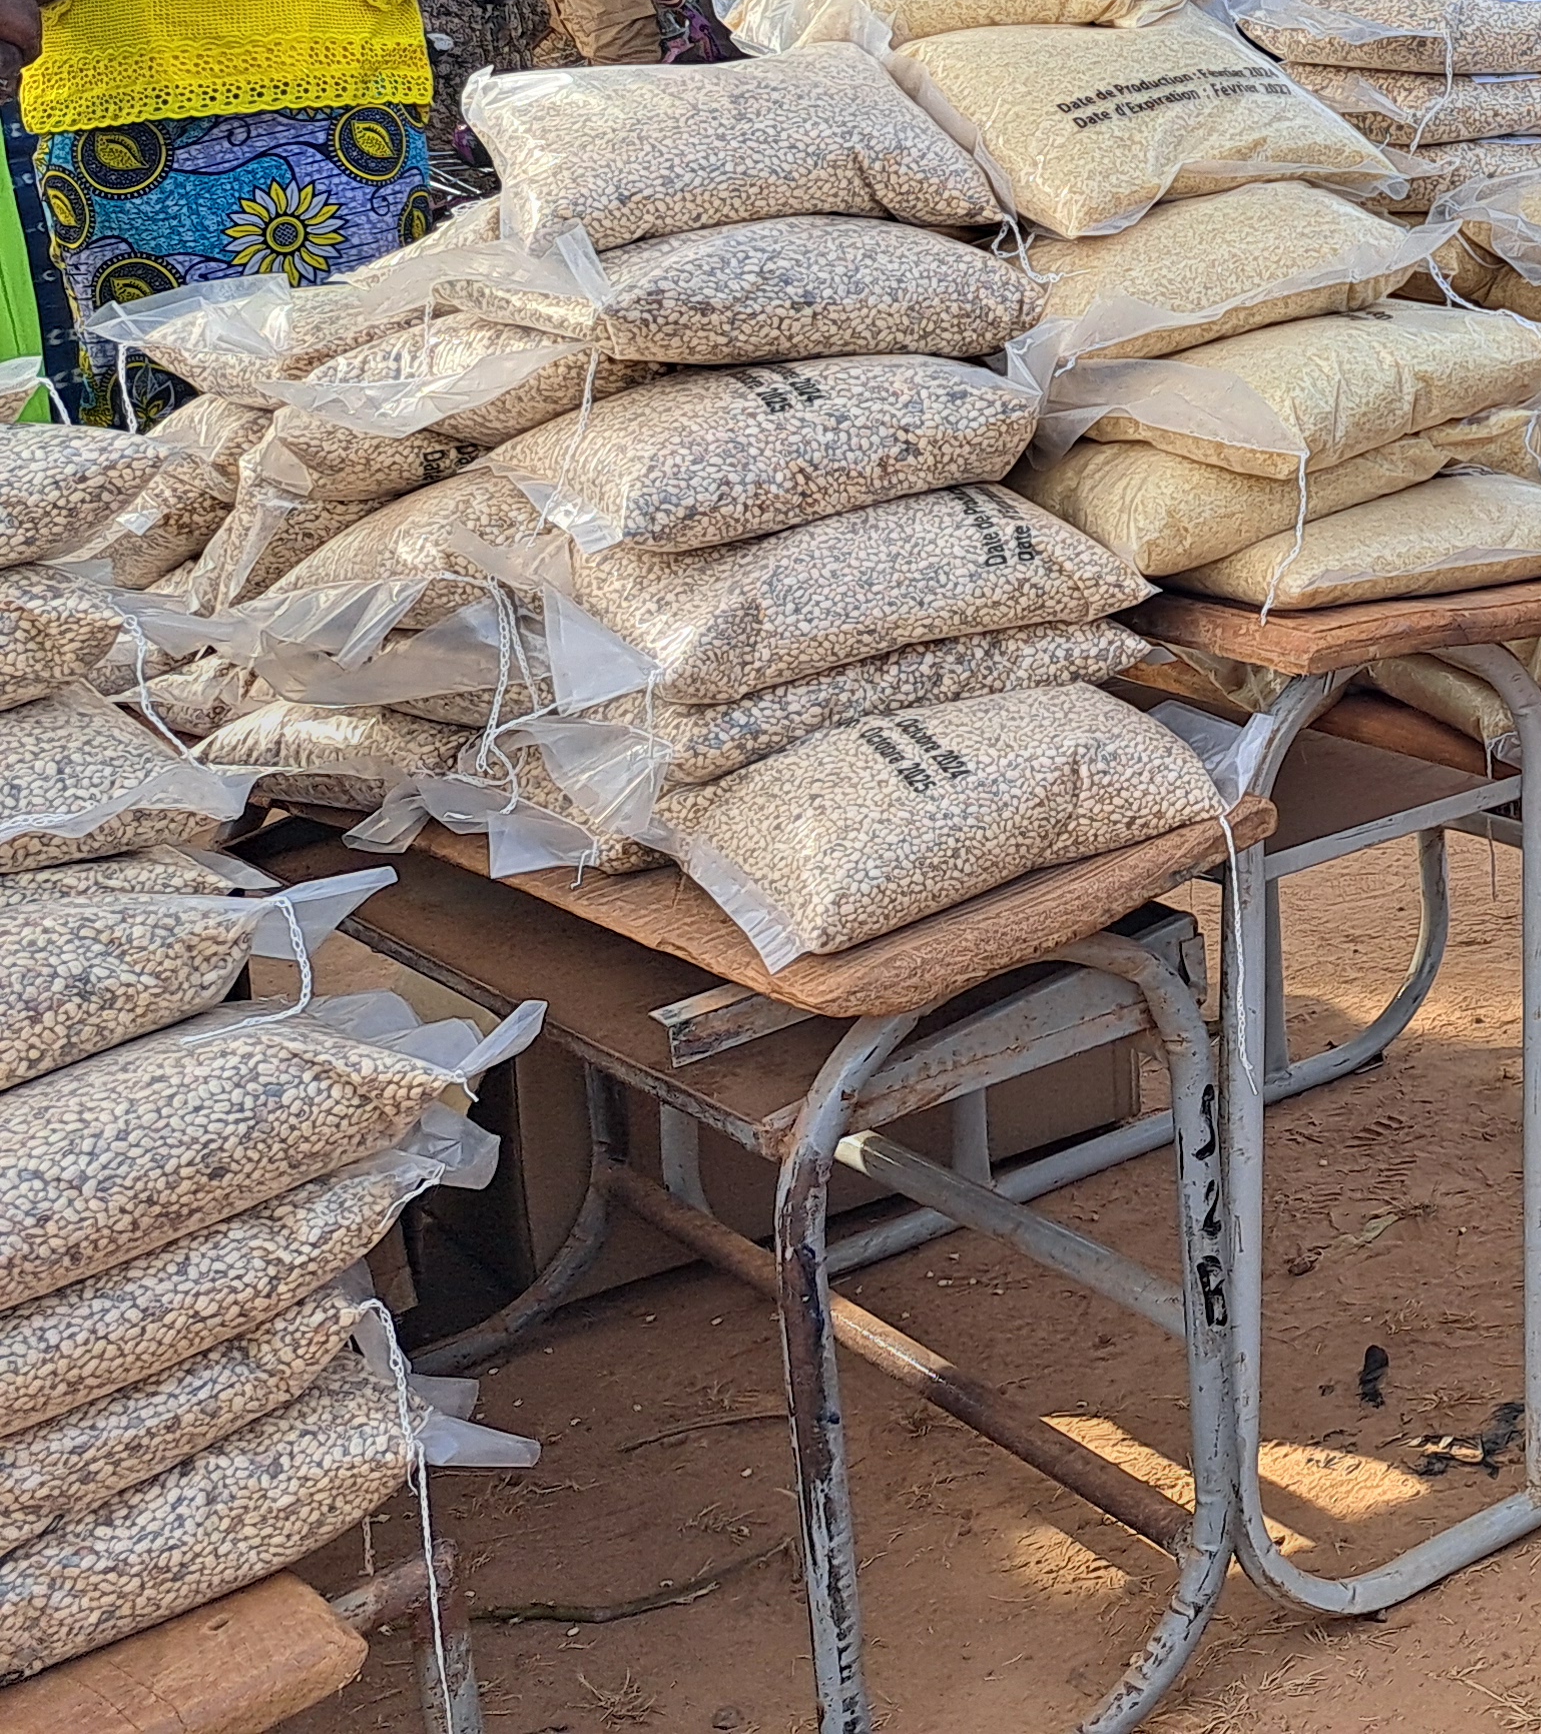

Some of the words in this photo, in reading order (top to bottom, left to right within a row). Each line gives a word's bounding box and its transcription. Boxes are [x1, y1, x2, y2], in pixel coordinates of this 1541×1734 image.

[1056, 94, 1094, 114] Date
[1095, 88, 1116, 102] de
[1246, 66, 1279, 79] 2024
[1072, 111, 1110, 130] Date
[1114, 89, 1202, 116] d'Expiration
[1211, 81, 1260, 99] Février
[981, 531, 1008, 567] Date
[860, 726, 906, 765] Octobre
[895, 762, 938, 794] 2025
[895, 718, 942, 754] Octobre
[931, 749, 972, 779] 2024
